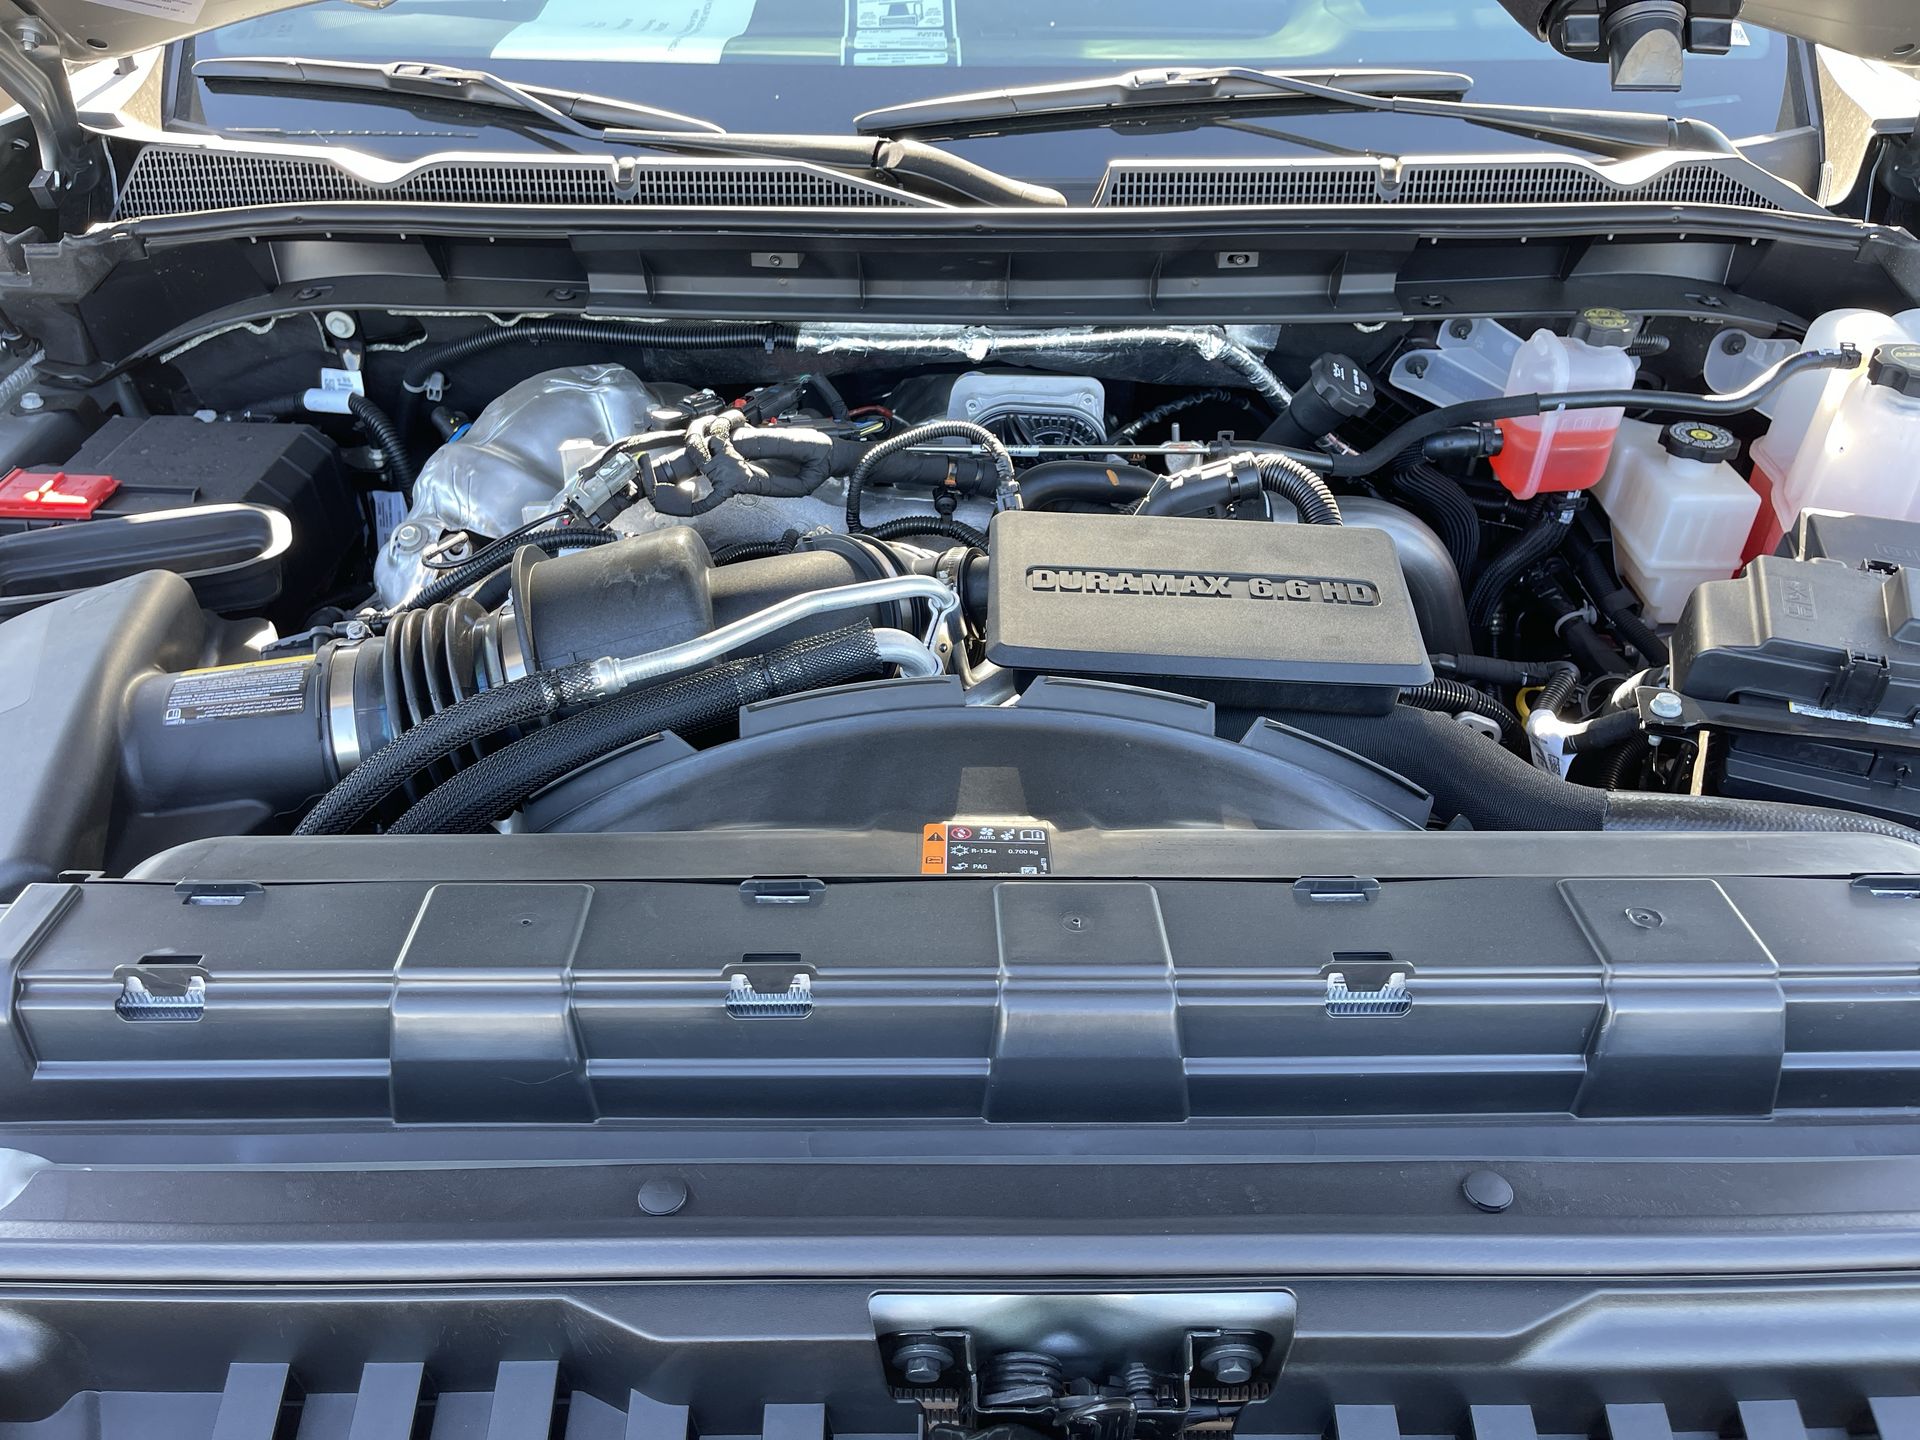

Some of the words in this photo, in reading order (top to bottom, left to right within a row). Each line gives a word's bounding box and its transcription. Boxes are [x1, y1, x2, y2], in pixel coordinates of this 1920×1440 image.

[1032, 569, 1232, 598] DURAMAX
[1248, 577, 1311, 601] 6.6
[1319, 581, 1375, 605] HD
